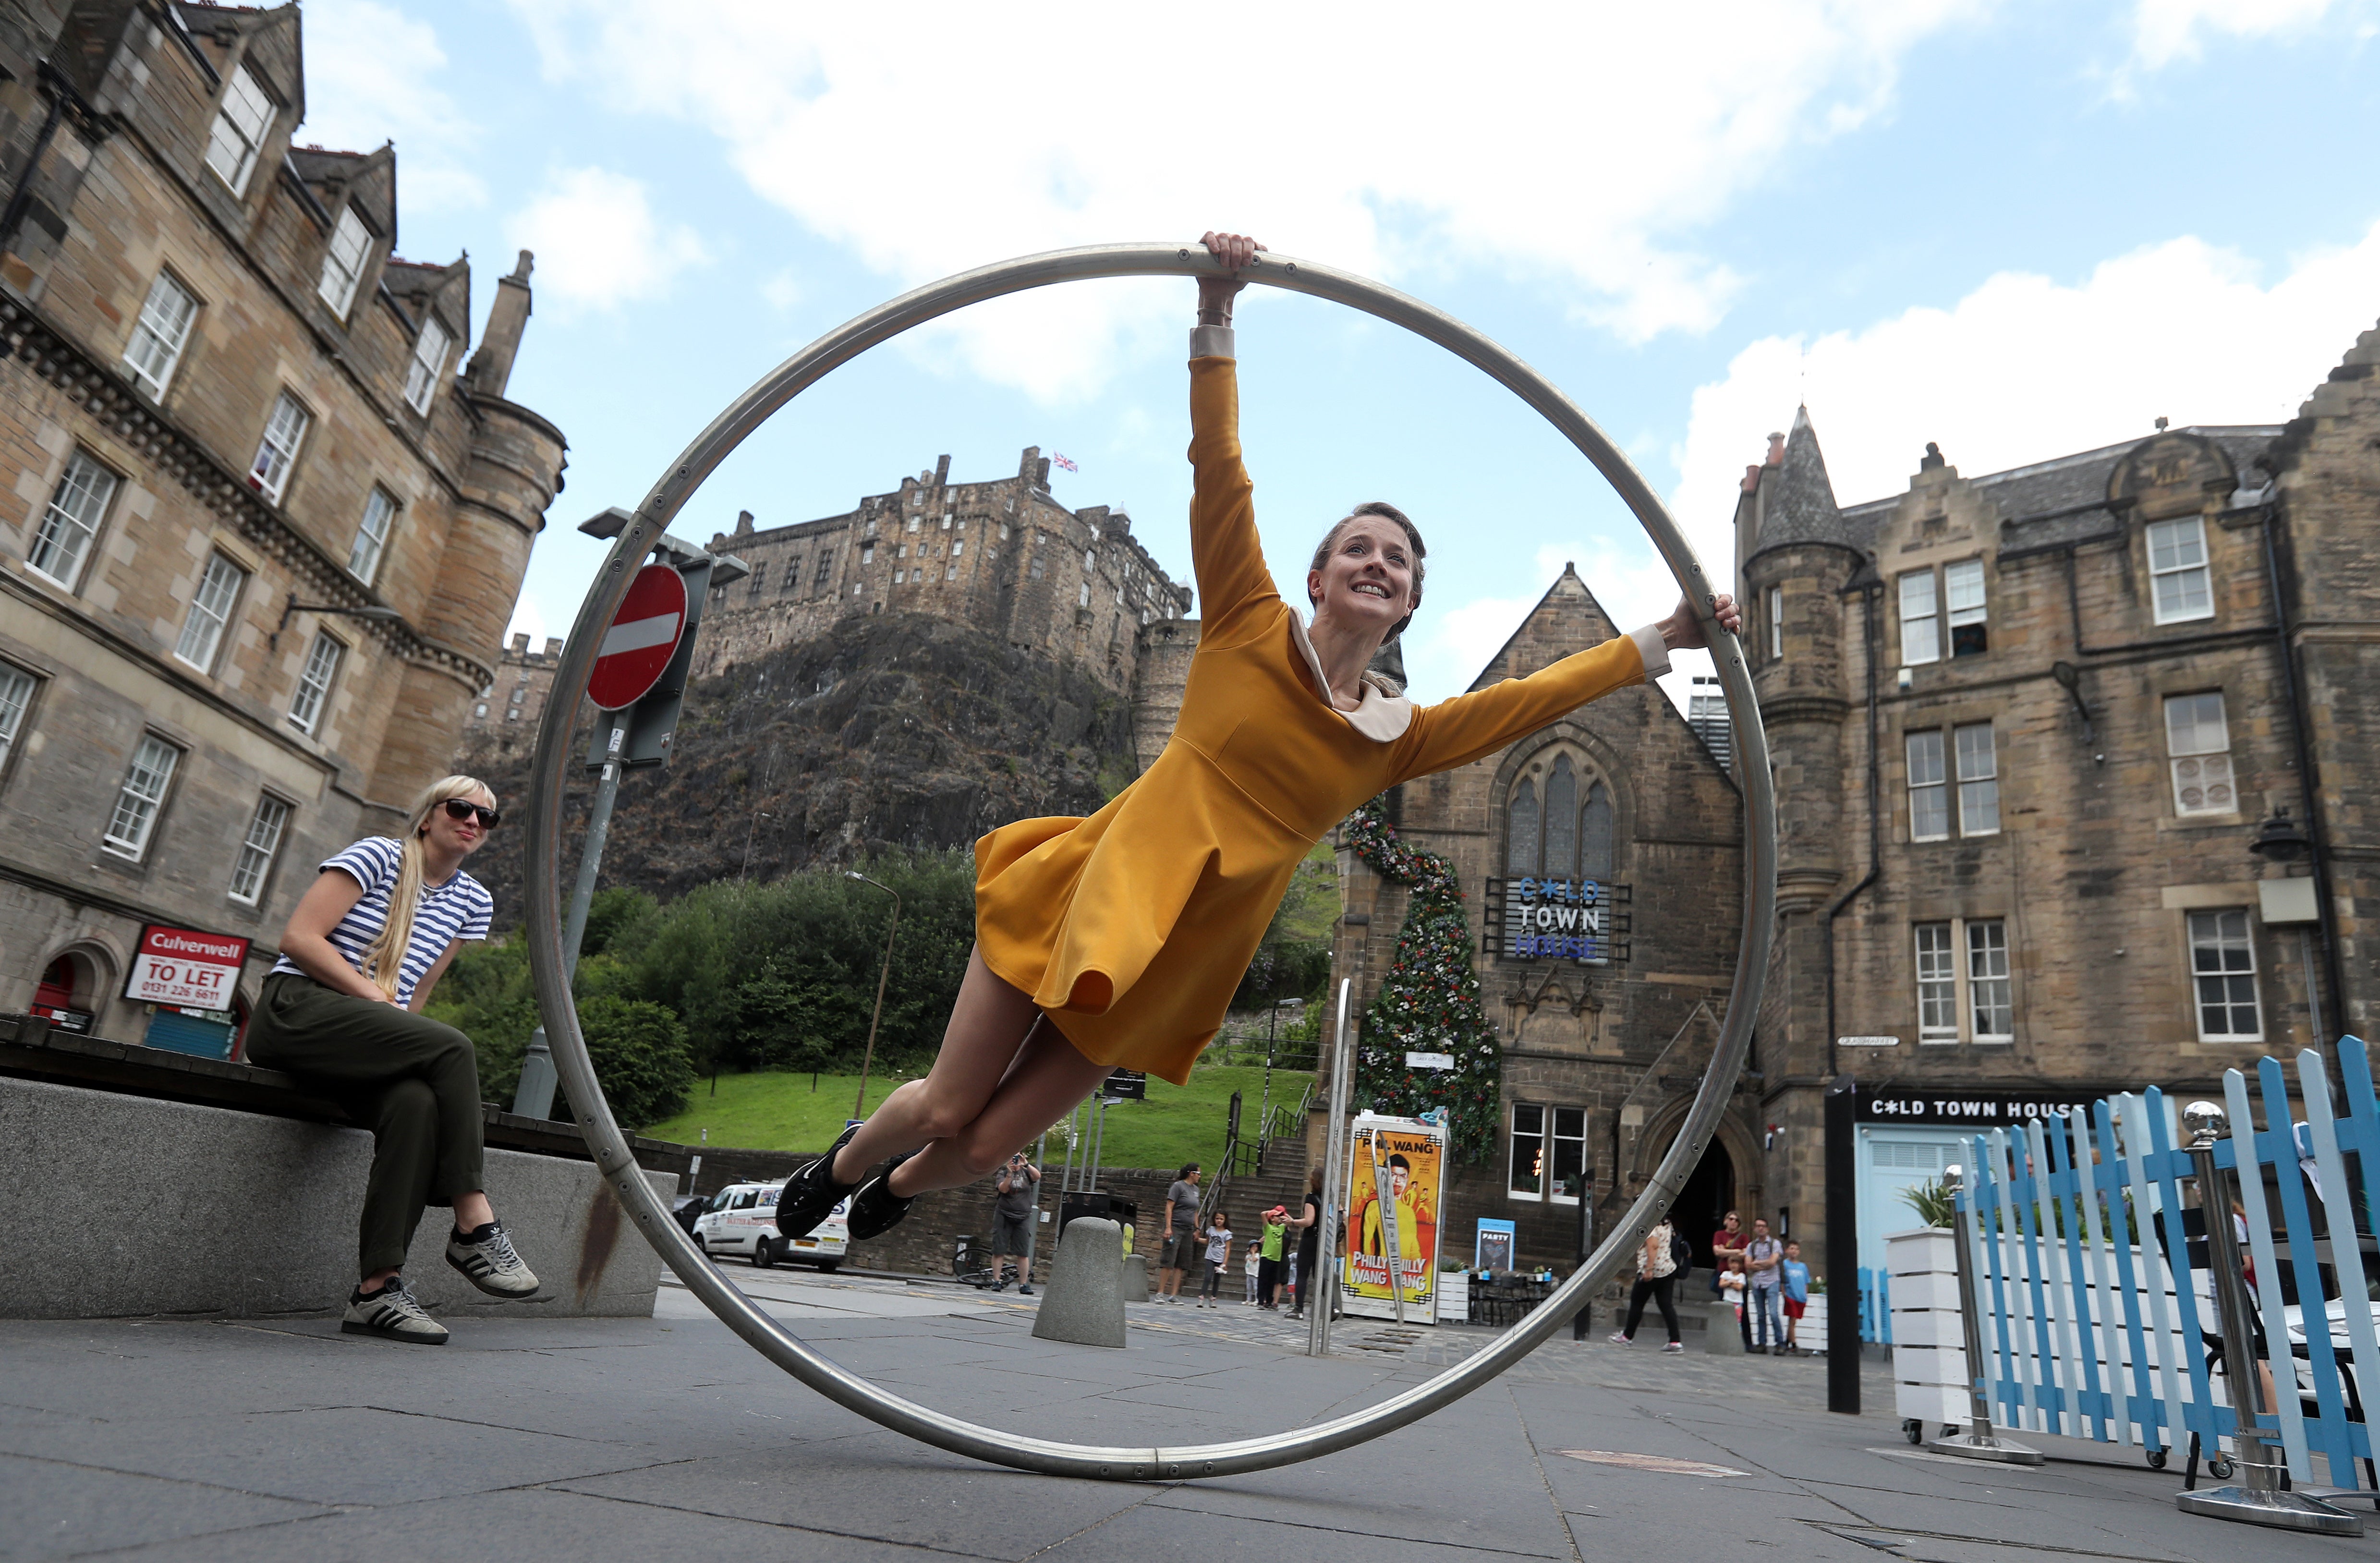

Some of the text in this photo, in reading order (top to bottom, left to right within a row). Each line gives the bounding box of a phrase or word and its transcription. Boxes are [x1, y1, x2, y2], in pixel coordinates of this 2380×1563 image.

[1518, 906, 1599, 930] TOWN
[150, 933, 241, 959] Culverwell
[1515, 934, 1597, 959] HOUSE
[149, 963, 225, 988] TO LET
[142, 981, 219, 1000] 0131 226 6611
[1933, 1101, 1997, 1117] TOWN
[2007, 1103, 2085, 1119] HOUS
[1393, 1140, 1433, 1154] WANG
[1482, 1233, 1509, 1241] PARTY
[1352, 1251, 1427, 1274] PHILLY ILLY
[1350, 1268, 1387, 1285] WANG
[1400, 1274, 1426, 1292] ANG
